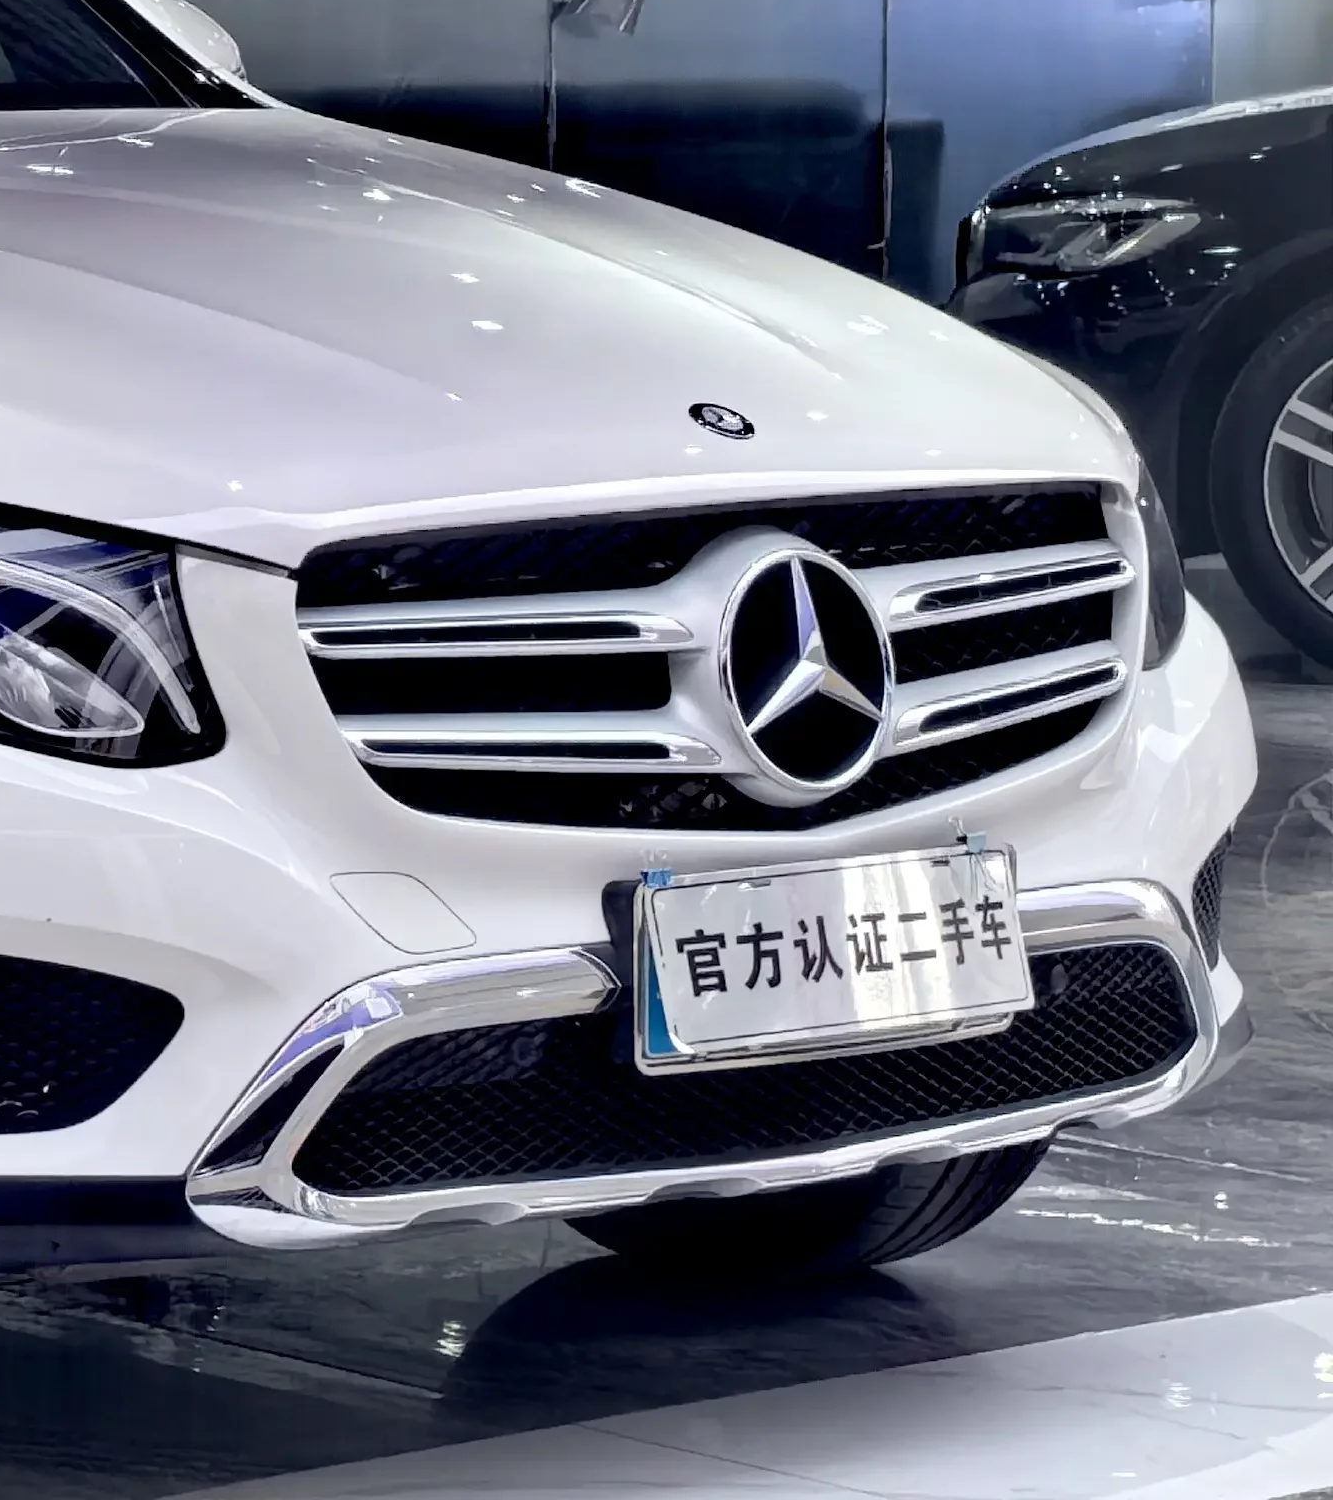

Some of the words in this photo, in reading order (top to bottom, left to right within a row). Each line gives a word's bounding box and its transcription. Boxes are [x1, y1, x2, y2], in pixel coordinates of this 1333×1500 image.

[675, 895, 1013, 997] 官方认证二手车
